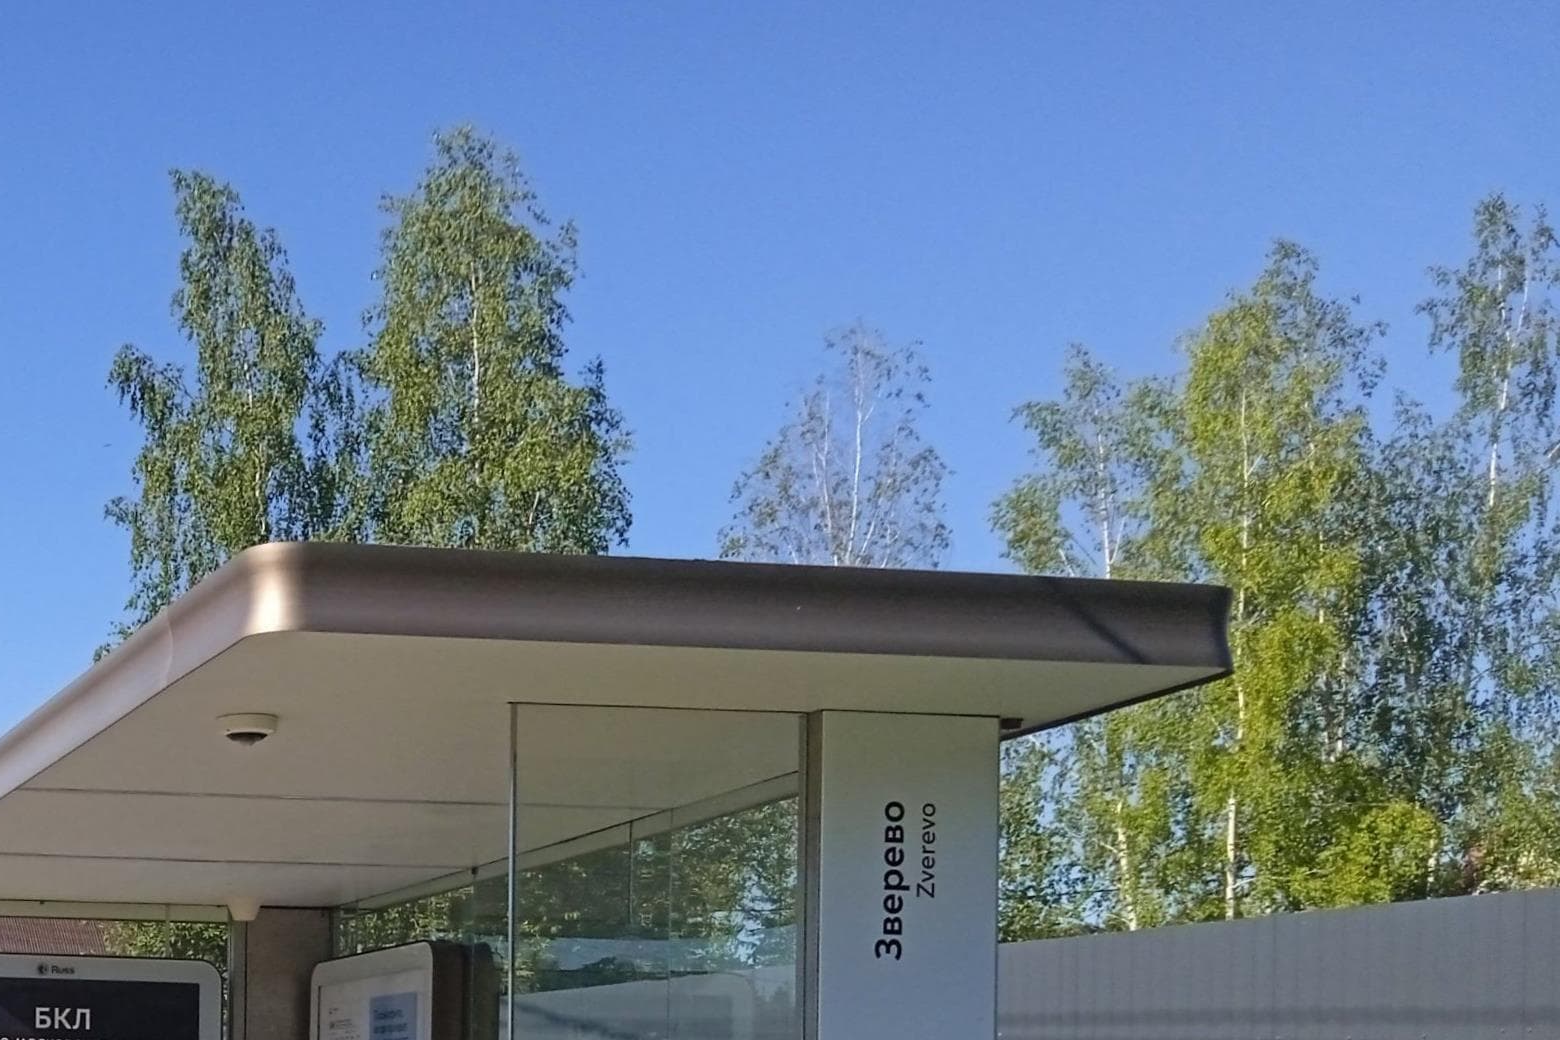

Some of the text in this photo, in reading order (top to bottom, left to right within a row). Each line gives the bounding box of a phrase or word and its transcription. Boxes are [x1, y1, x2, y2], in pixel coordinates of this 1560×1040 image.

[874, 801, 910, 961] Зверево
[916, 803, 936, 898] Zverevo
[35, 1007, 91, 1030] БКЛ
